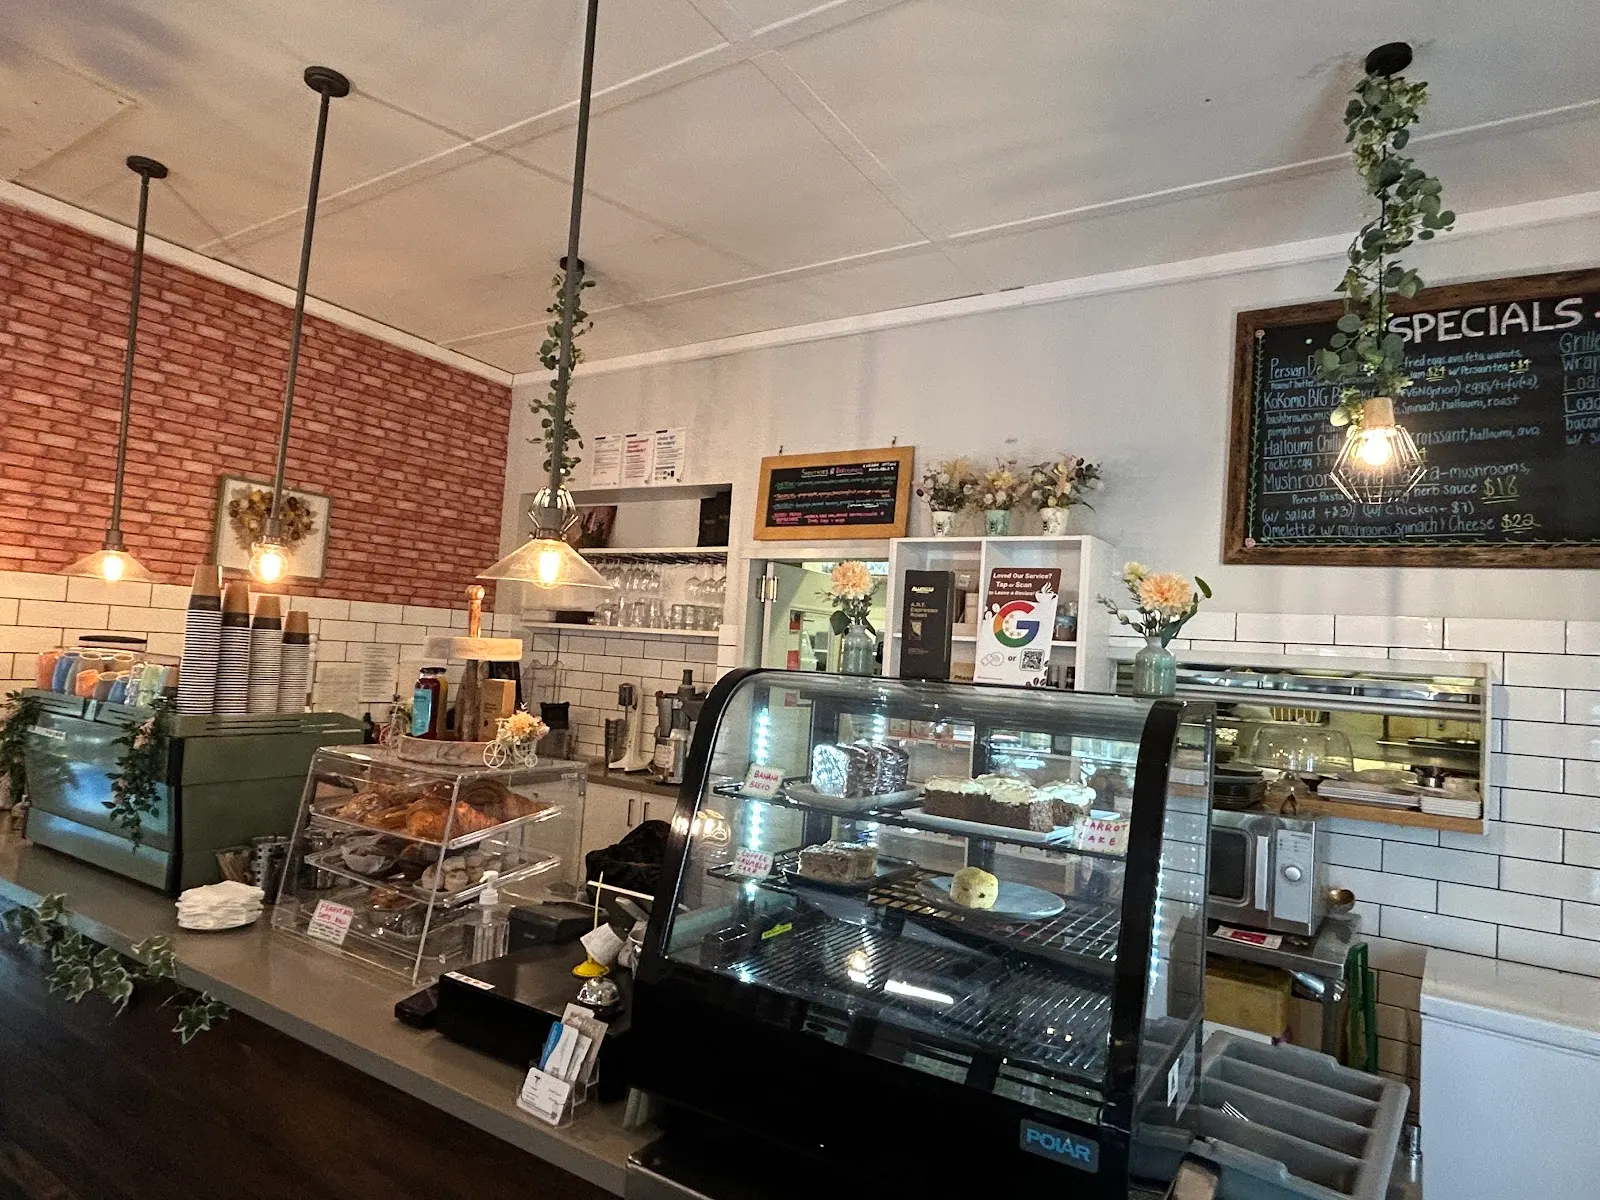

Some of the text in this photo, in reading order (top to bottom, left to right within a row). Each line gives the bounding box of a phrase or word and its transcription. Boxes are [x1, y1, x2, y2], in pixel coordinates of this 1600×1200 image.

[1388, 297, 1583, 343] SPECIALS
[1308, 387, 1329, 408] BIG
[1263, 437, 1314, 456] Halloumi
[1285, 507, 1316, 520] salad
[1262, 522, 1316, 537] Omelette
[1448, 515, 1495, 531] Cheese
[996, 581, 1009, 589] Tap
[1082, 820, 1128, 832] CARROT
[1078, 831, 1116, 846] CAKE
[1026, 1128, 1091, 1163] POLAR
